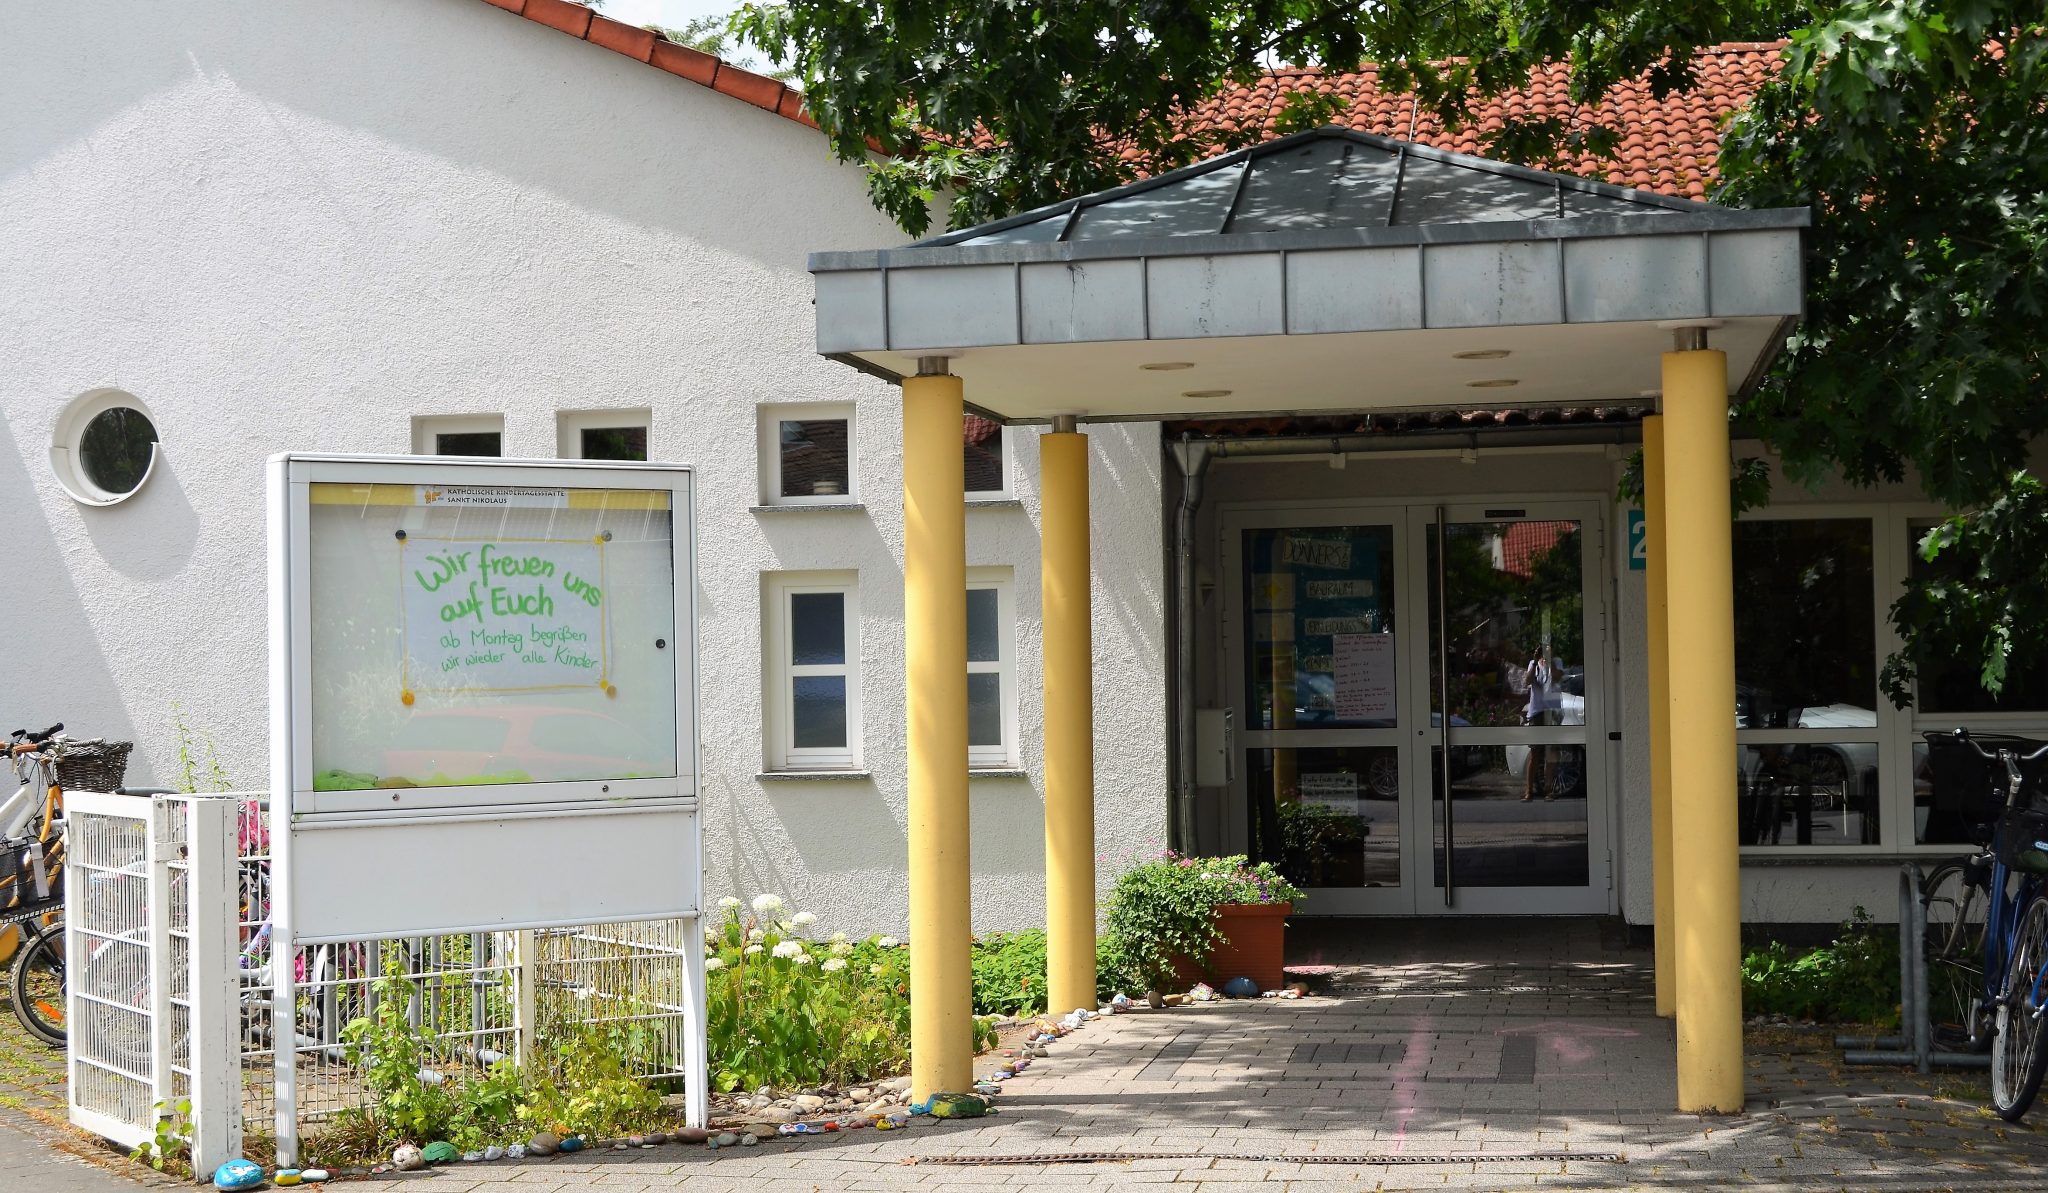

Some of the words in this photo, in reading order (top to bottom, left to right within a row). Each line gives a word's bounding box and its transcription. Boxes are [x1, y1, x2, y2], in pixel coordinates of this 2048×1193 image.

[415, 549, 471, 592] Wir
[478, 544, 555, 588] freuen
[563, 571, 602, 607] uns
[440, 580, 483, 623] auf
[490, 584, 554, 617] Euch
[440, 630, 461, 648] ab
[471, 629, 523, 653] Montag
[441, 656, 460, 672] wir
[465, 651, 504, 665] wieder
[522, 651, 547, 664] alle
[554, 646, 599, 669] Kinder
